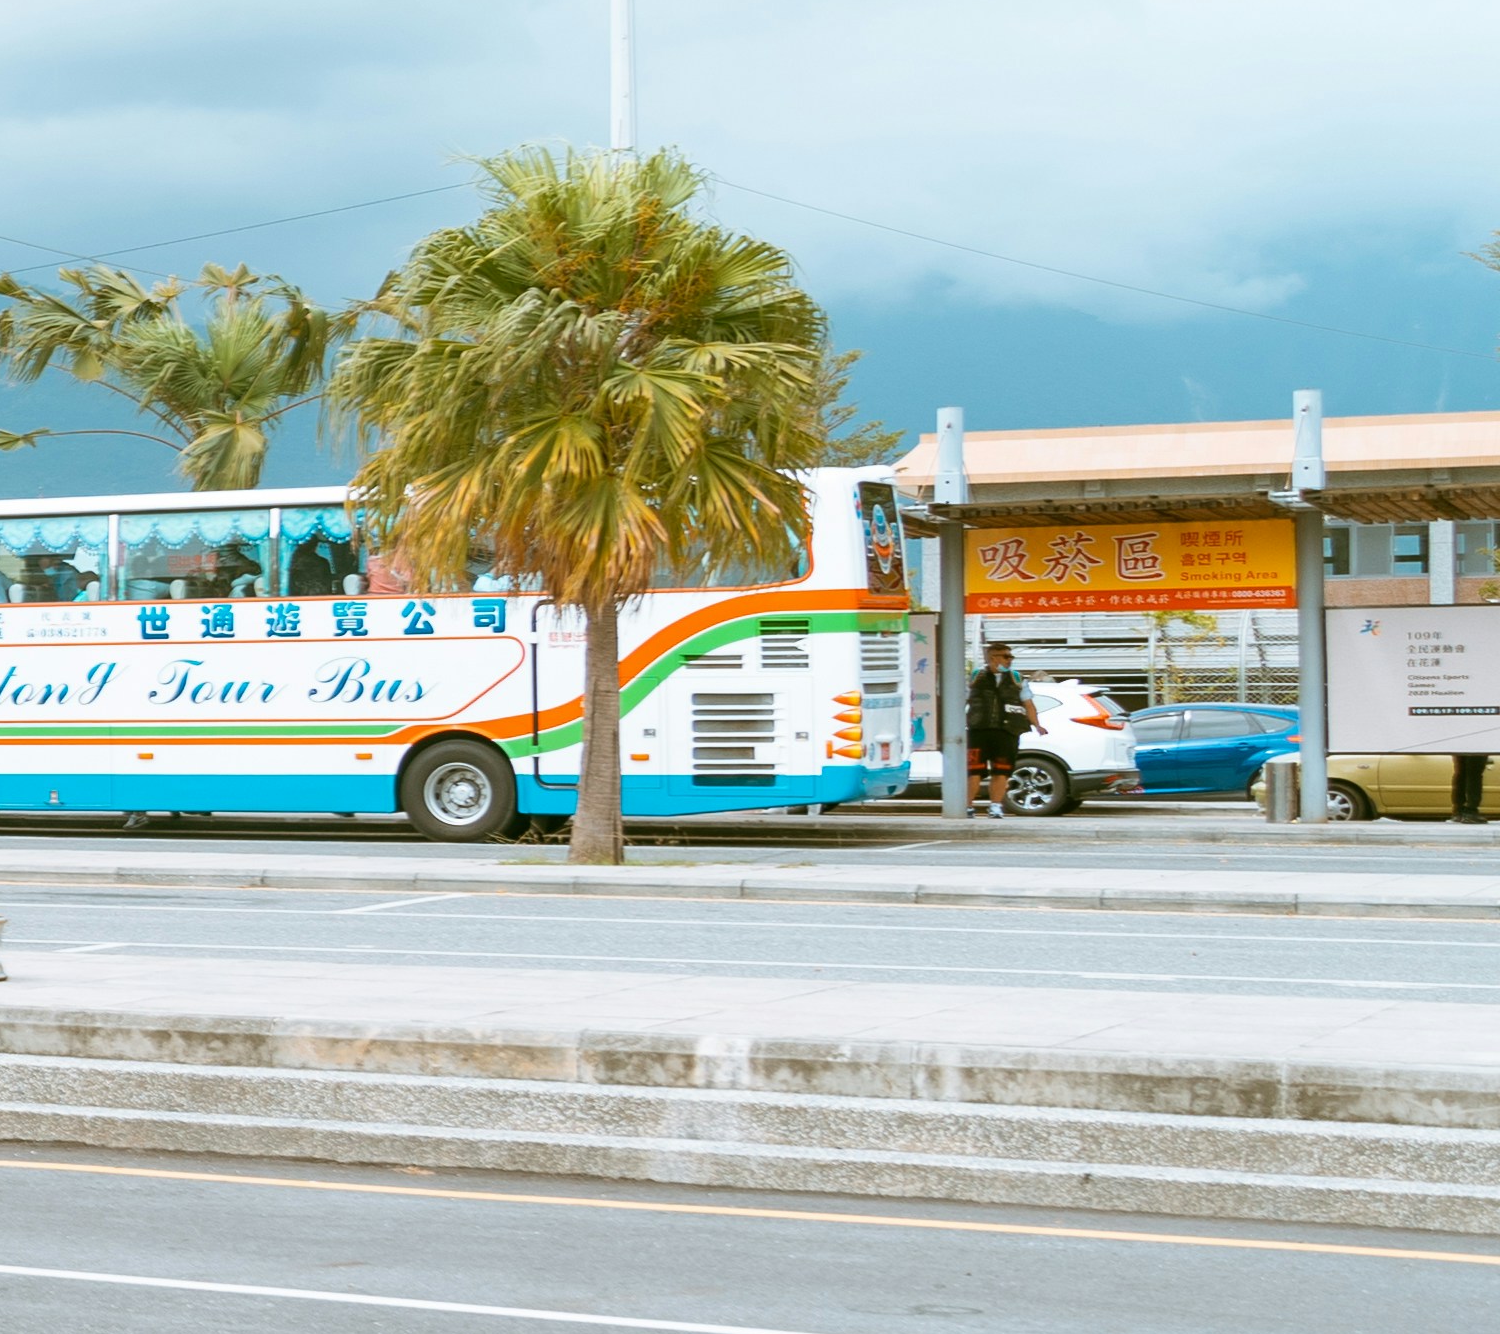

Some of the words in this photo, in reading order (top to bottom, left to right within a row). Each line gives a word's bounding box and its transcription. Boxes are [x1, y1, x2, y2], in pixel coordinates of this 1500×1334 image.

[978, 531, 1165, 584] 吸菸區
[1180, 530, 1243, 548] 喫煙所
[1179, 570, 1242, 583] Smoking
[1245, 569, 1279, 581] Area
[137, 598, 508, 641] 世通遊覽公司
[148, 658, 288, 706] Tour
[306, 656, 440, 705] Bus
